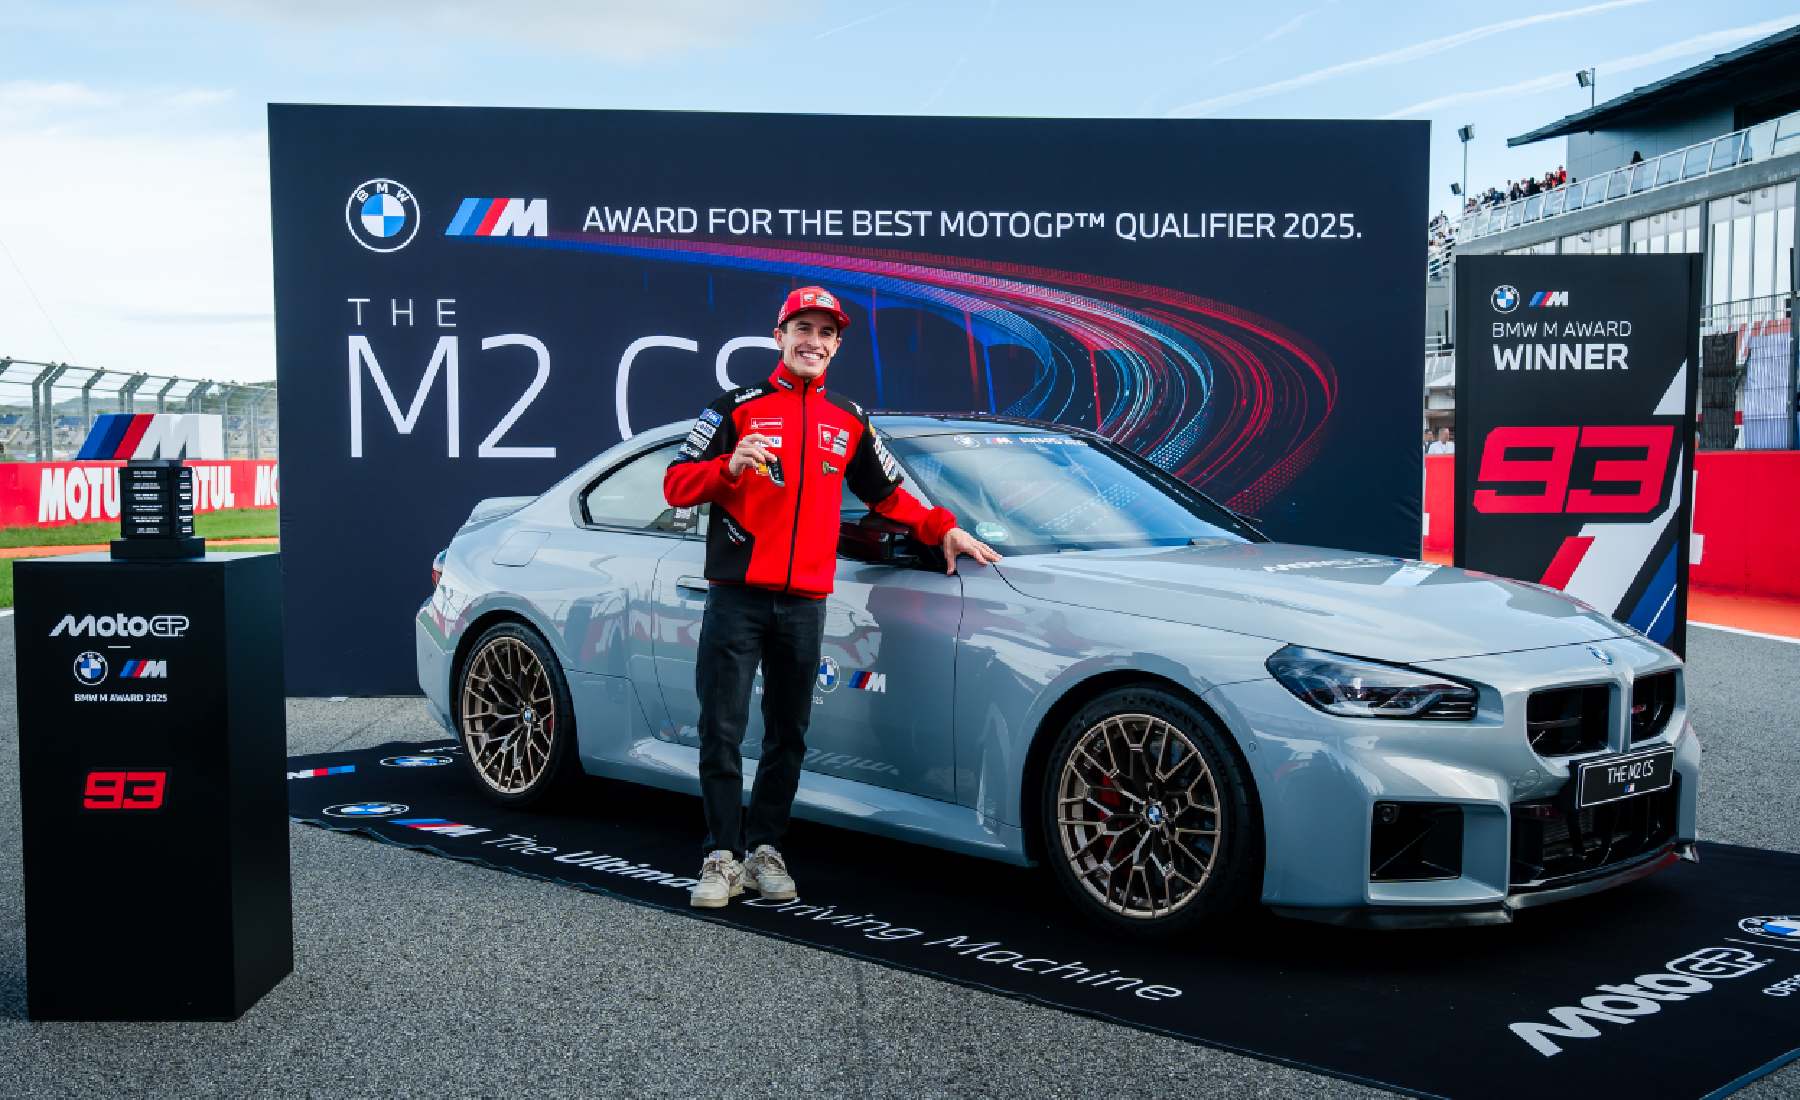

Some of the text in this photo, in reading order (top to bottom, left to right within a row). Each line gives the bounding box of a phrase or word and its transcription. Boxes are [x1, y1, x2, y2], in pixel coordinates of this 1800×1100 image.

[583, 206, 698, 234] AWARD
[708, 207, 773, 235] FOR
[779, 209, 844, 236] THE
[852, 210, 932, 237] BEST
[1115, 212, 1275, 240] QUALIFIER
[1283, 212, 1362, 240] 2025.
[348, 298, 457, 327] THE
[1492, 320, 1632, 338] BMW M AWARD
[1492, 343, 1629, 370] WINNER
[348, 334, 557, 458] M2
[1473, 425, 1675, 513] 93
[38, 467, 120, 522] MOTU
[49, 613, 190, 637] MotoGP
[74, 693, 168, 702] BMW M AWARD 2025
[1607, 765, 1627, 784] THE
[1642, 759, 1654, 777] CS
[83, 771, 167, 809] 93
[482, 833, 557, 856] The
[922, 934, 1184, 1001] Machine
